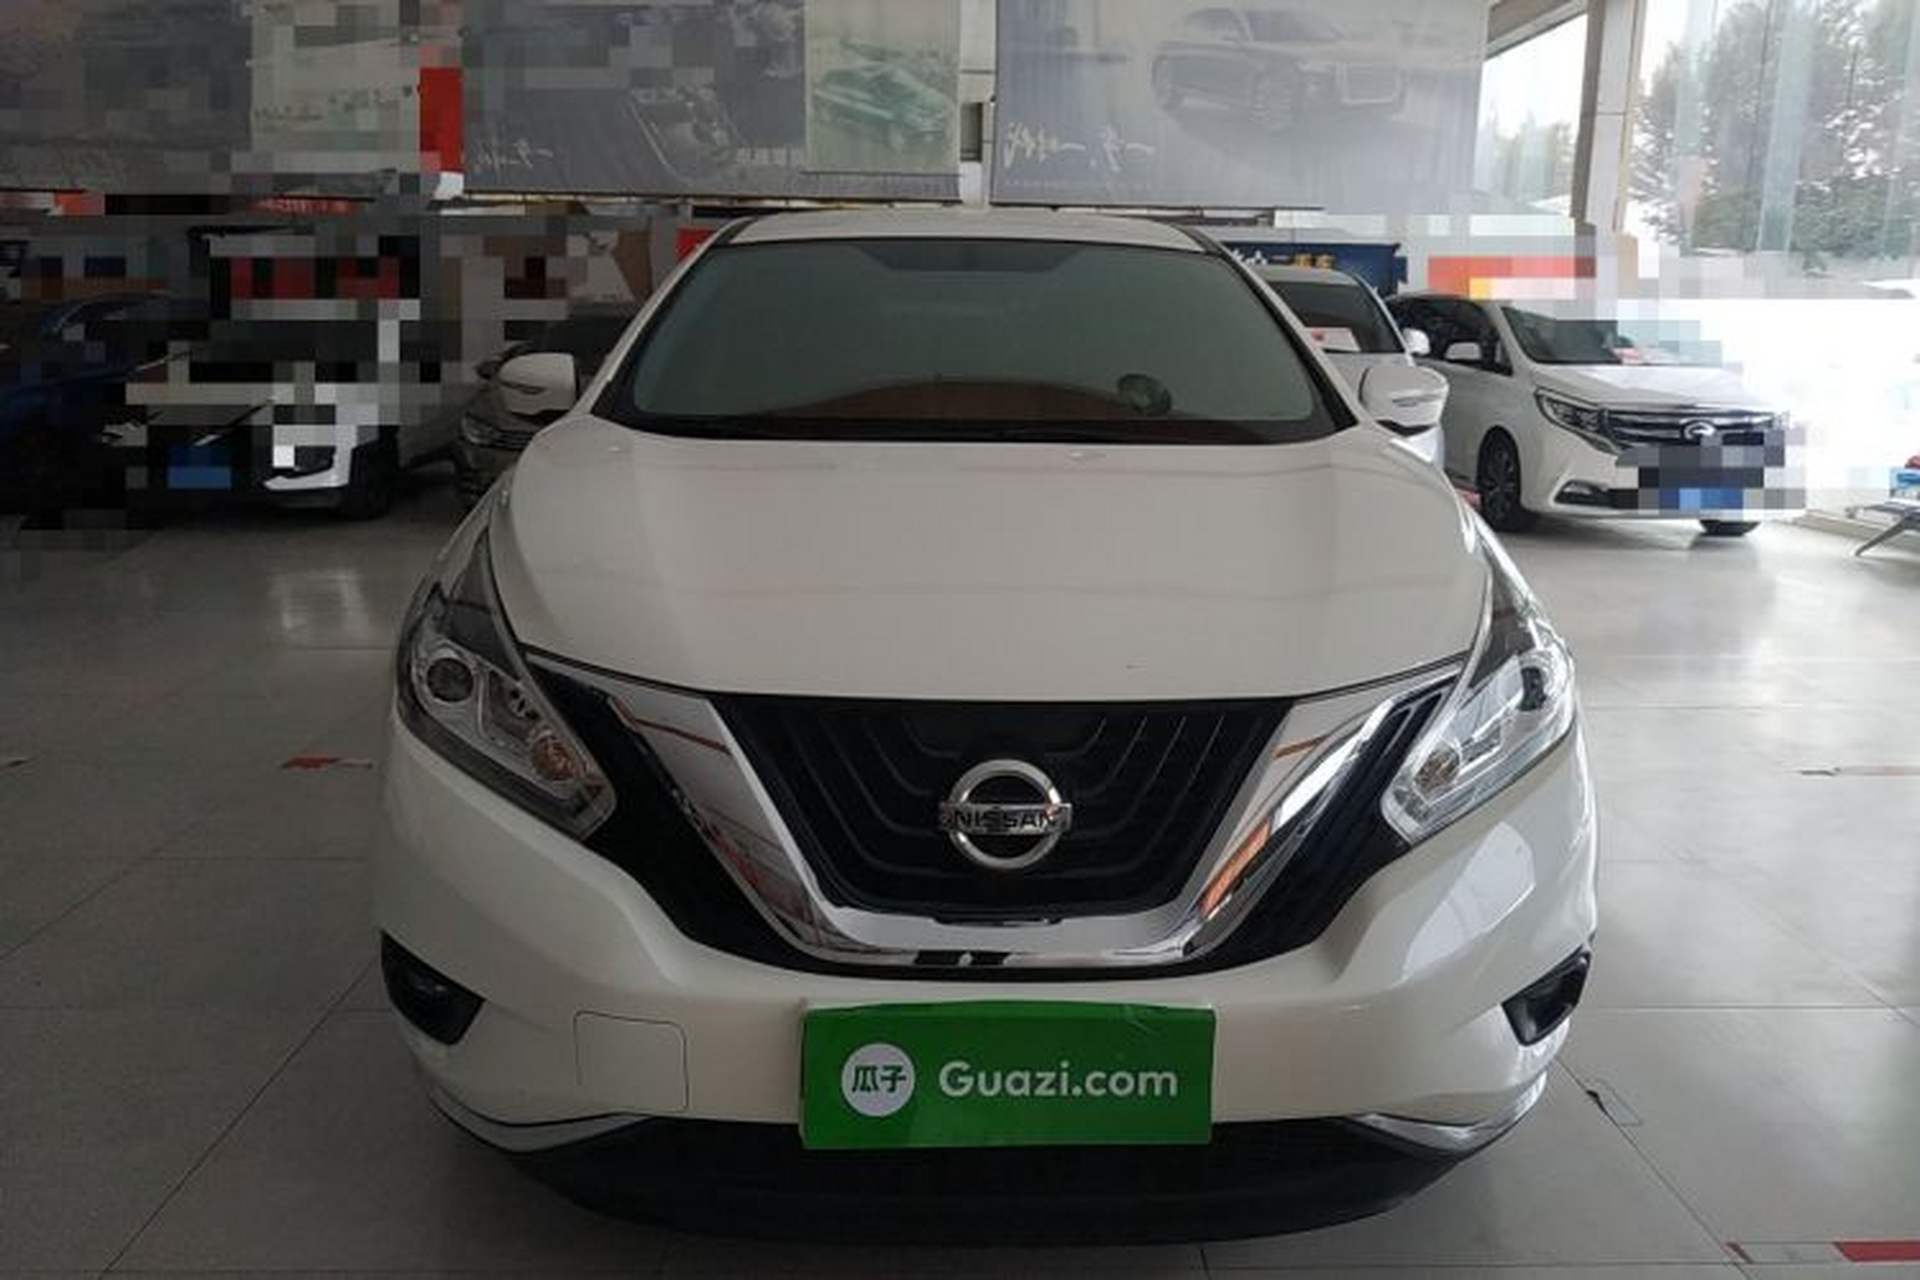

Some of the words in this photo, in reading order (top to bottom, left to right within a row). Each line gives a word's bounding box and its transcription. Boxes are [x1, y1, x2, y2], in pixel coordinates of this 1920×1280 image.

[954, 808, 1060, 829] NISSAN
[851, 1064, 907, 1094] 瓜子
[938, 1060, 1178, 1098] Guazi.com
